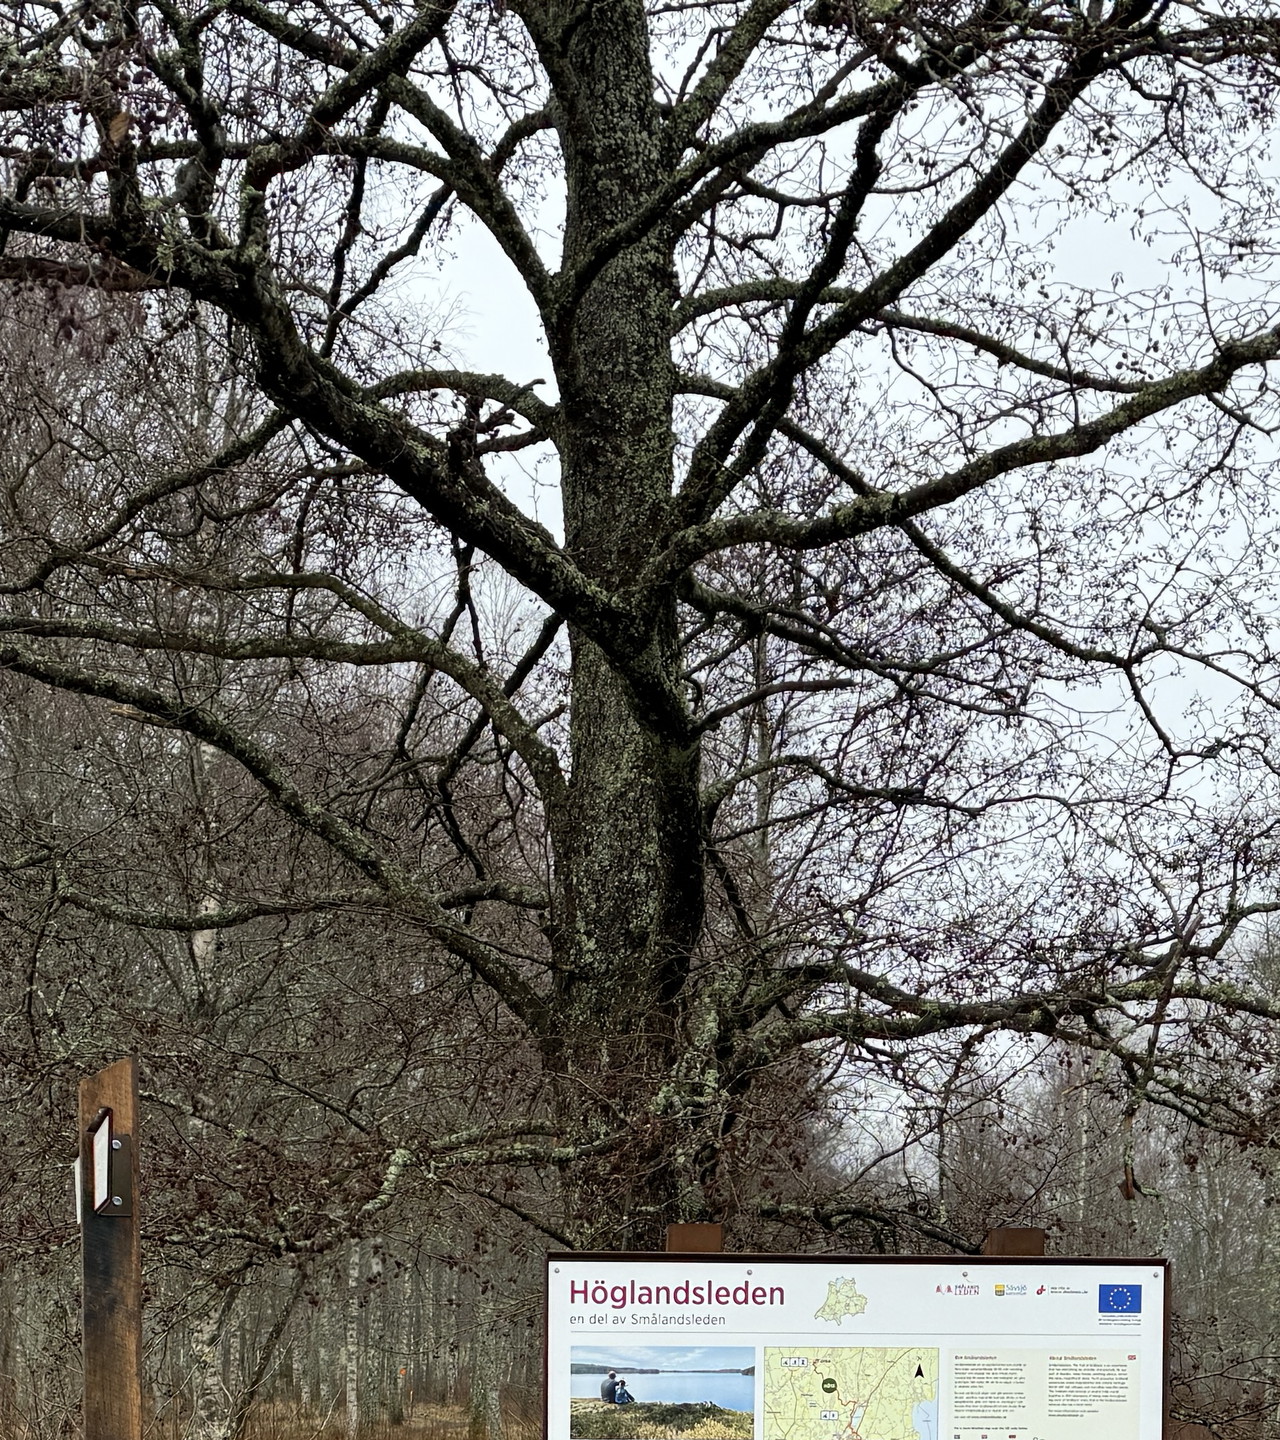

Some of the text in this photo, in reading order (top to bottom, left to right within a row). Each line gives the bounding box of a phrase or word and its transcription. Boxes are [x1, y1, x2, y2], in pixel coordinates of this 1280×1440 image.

[570, 1279, 785, 1309] Höglandsleden
[569, 1313, 726, 1325] en del av Smålandsleden
